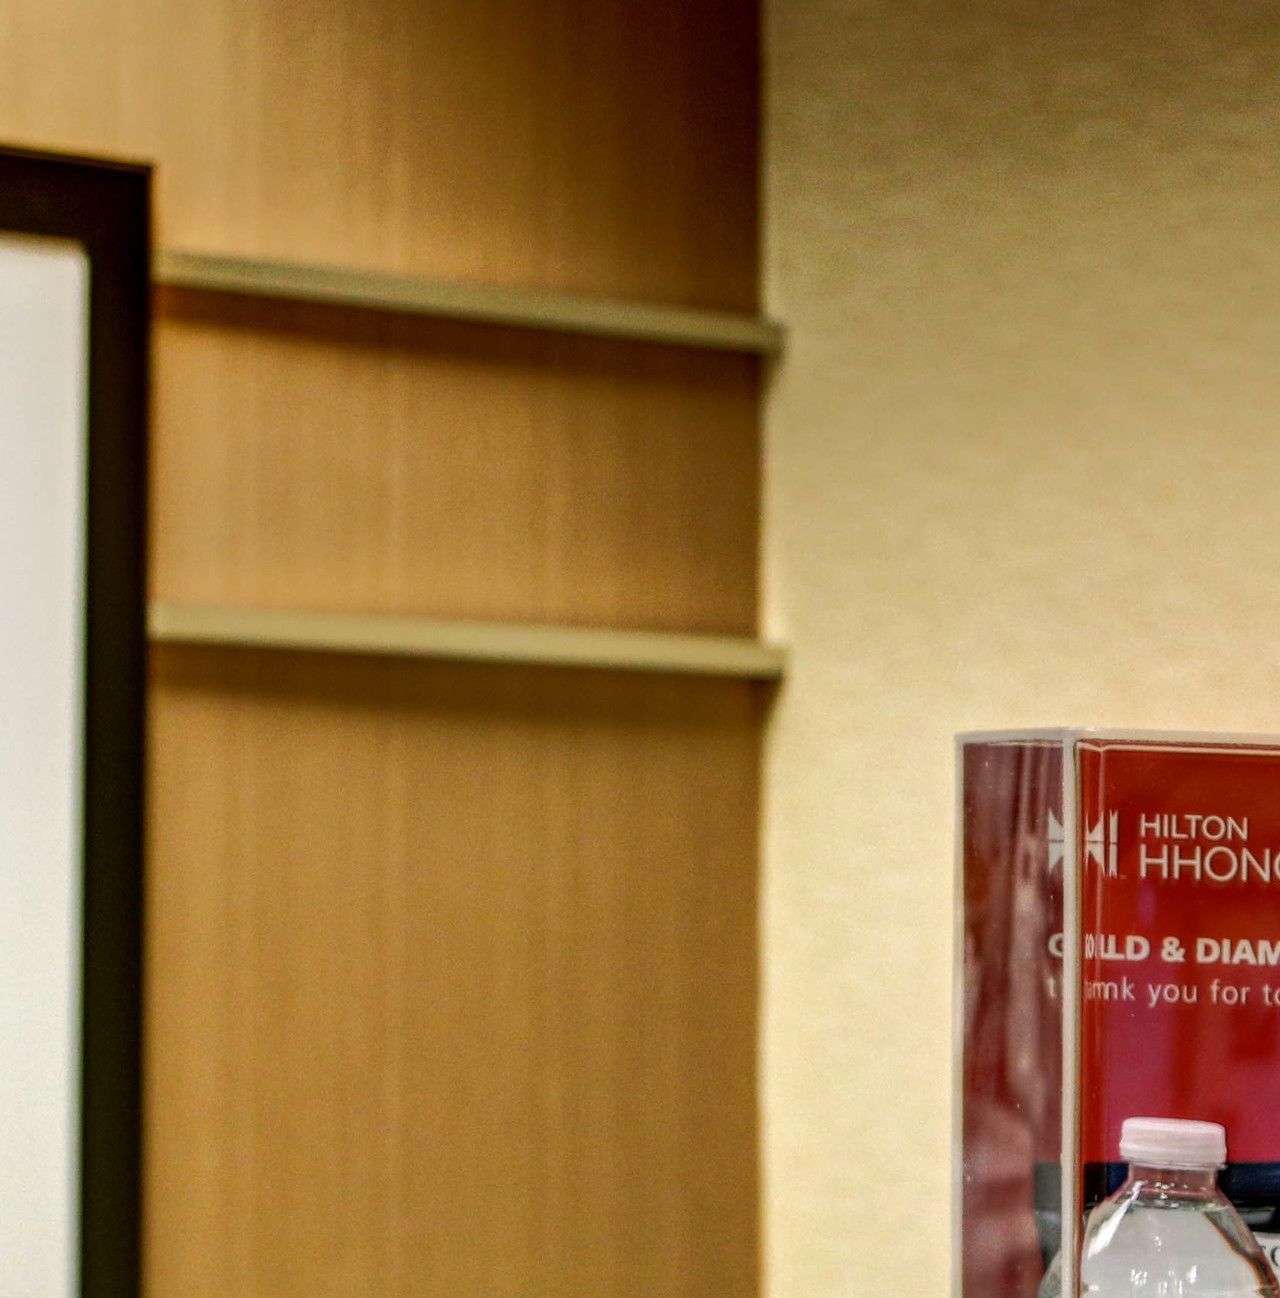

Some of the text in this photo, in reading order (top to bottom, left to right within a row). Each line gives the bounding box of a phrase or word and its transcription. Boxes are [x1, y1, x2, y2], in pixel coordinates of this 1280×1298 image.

[1140, 813, 1248, 841] HILTON
[1160, 936, 1185, 963] &
[1148, 983, 1198, 1008] you
[1210, 979, 1251, 1005] for
